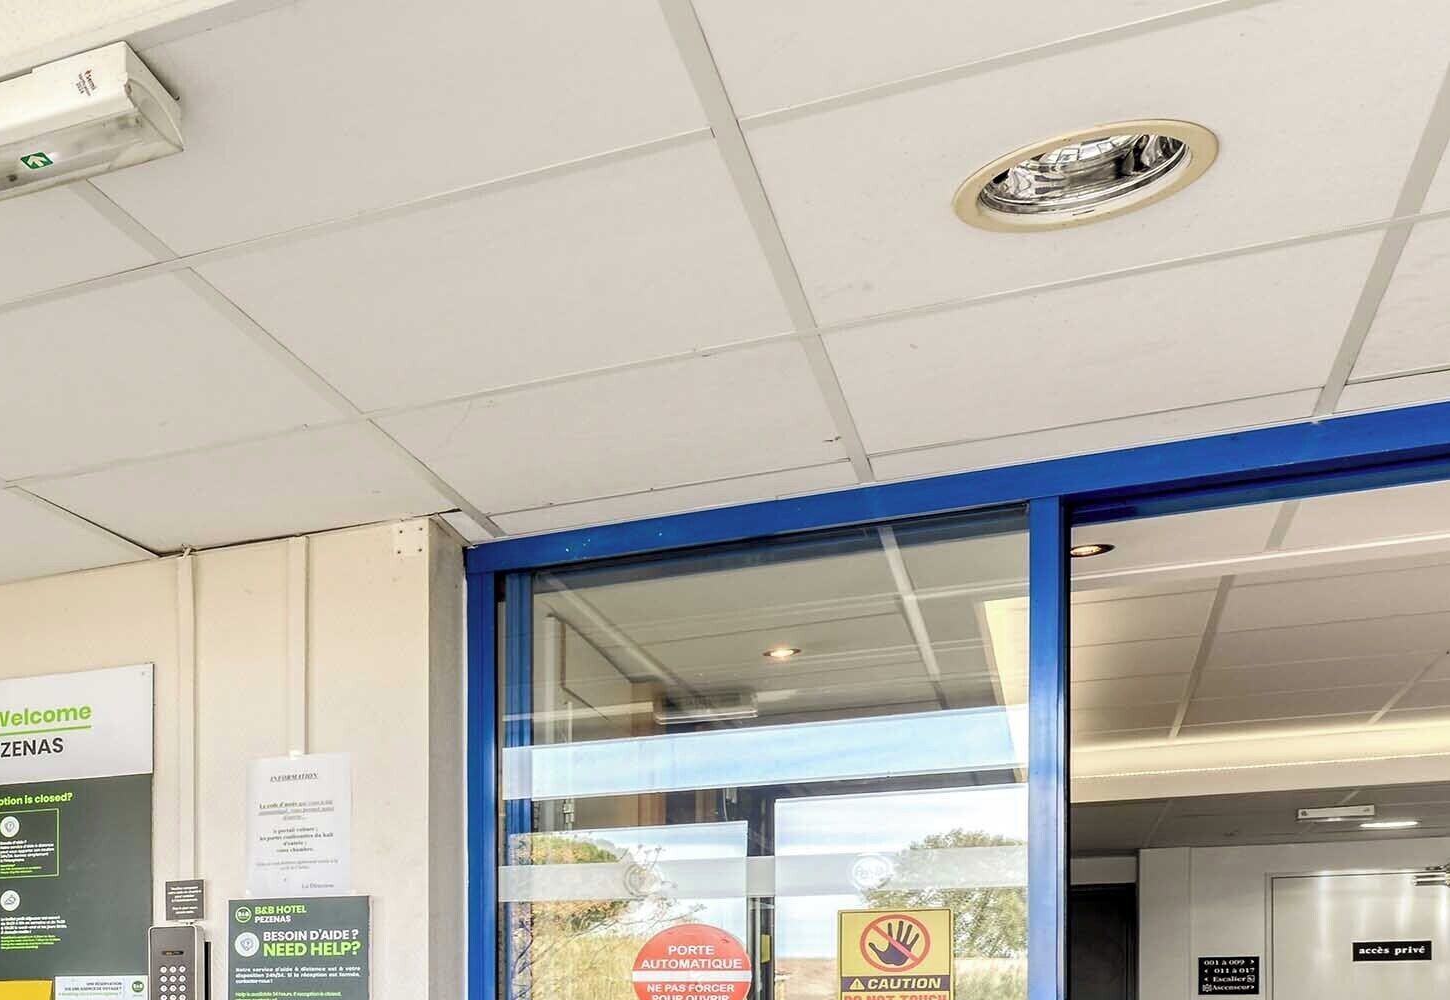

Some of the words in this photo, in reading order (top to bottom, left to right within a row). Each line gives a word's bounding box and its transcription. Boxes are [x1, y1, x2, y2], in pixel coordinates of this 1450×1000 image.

[269, 772, 318, 782] INFORMATION
[24, 794, 33, 805] is
[34, 791, 73, 804] closed?
[254, 905, 275, 915] B&B
[276, 904, 307, 914] HOTEL
[254, 915, 292, 924] PEZENAS
[263, 930, 307, 942] BESOIN
[309, 929, 350, 941] D'AIDE
[351, 929, 359, 940] ?
[263, 942, 308, 957] NEED
[310, 941, 361, 957] HELP?
[668, 945, 715, 956] PORTE
[1358, 945, 1390, 955] accès
[1394, 945, 1426, 956] privé
[641, 958, 743, 969] AUTOMATIQUE
[647, 984, 663, 993] NE
[664, 984, 687, 993] PAS
[688, 984, 735, 993] FORCER
[867, 977, 941, 990] CAUTION
